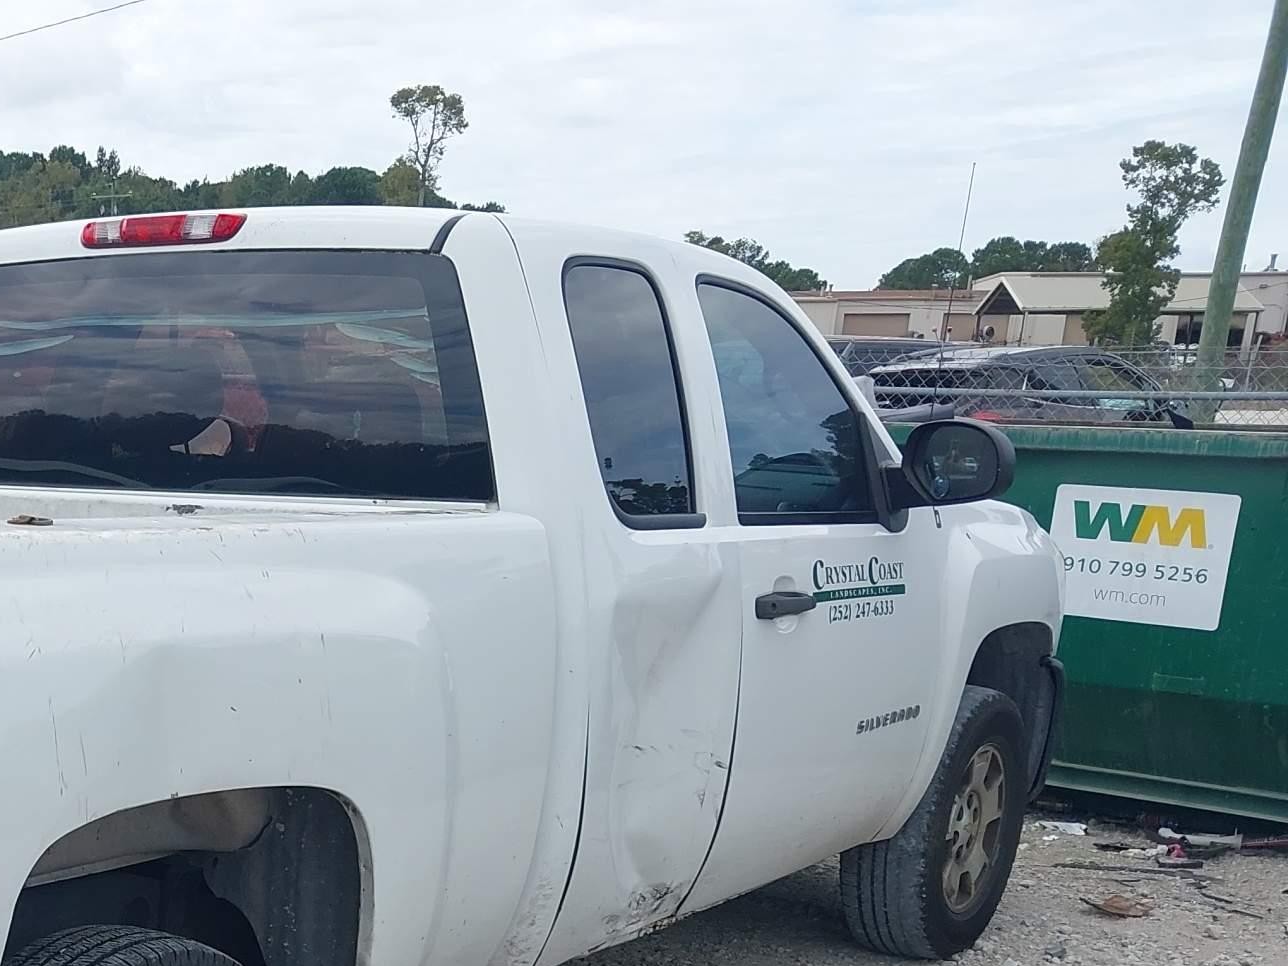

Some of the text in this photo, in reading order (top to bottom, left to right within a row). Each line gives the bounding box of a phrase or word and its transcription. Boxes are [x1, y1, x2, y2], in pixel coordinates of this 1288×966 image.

[1074, 500, 1207, 549] WM
[1063, 556, 1209, 584] 910 799 5256
[830, 586, 892, 599] LANDSCAPES, INC.
[1093, 588, 1166, 607] wm.com
[829, 600, 894, 625] (252) 247-6333
[856, 704, 921, 735] SILVERADO
